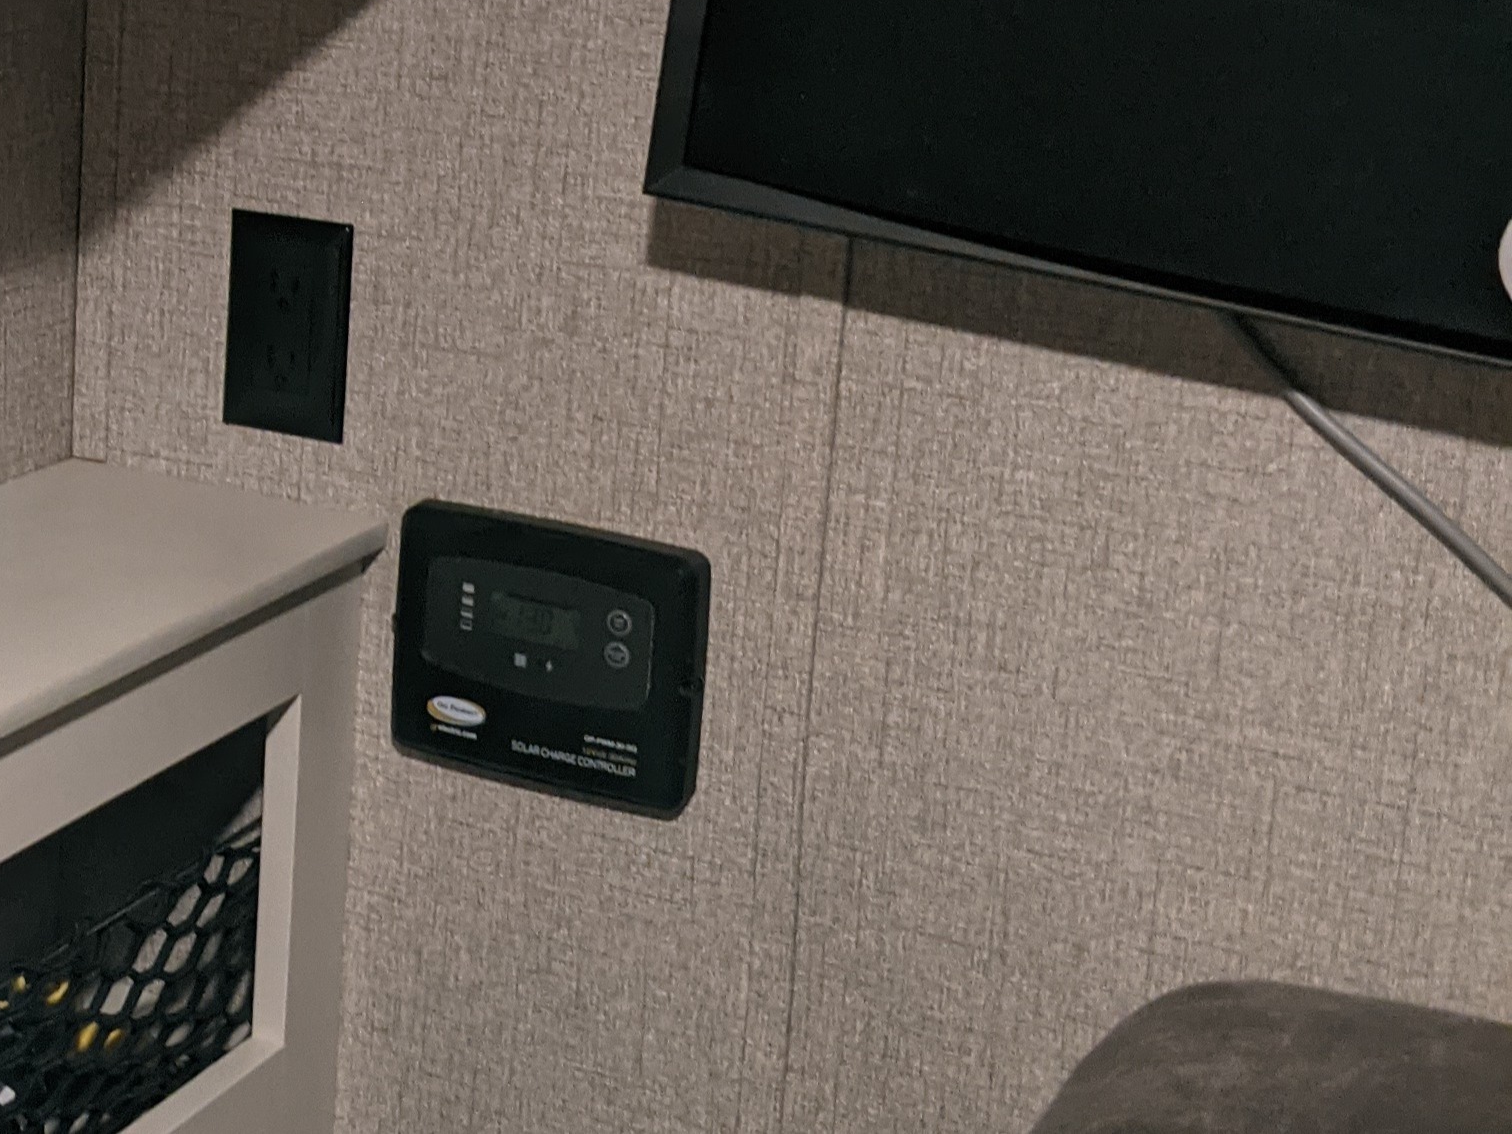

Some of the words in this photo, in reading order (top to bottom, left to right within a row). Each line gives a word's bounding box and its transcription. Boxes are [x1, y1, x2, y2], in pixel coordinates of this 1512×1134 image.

[511, 739, 541, 756] SOLAR
[540, 746, 578, 766] CHARGE
[577, 754, 637, 777] CONTROLLER
